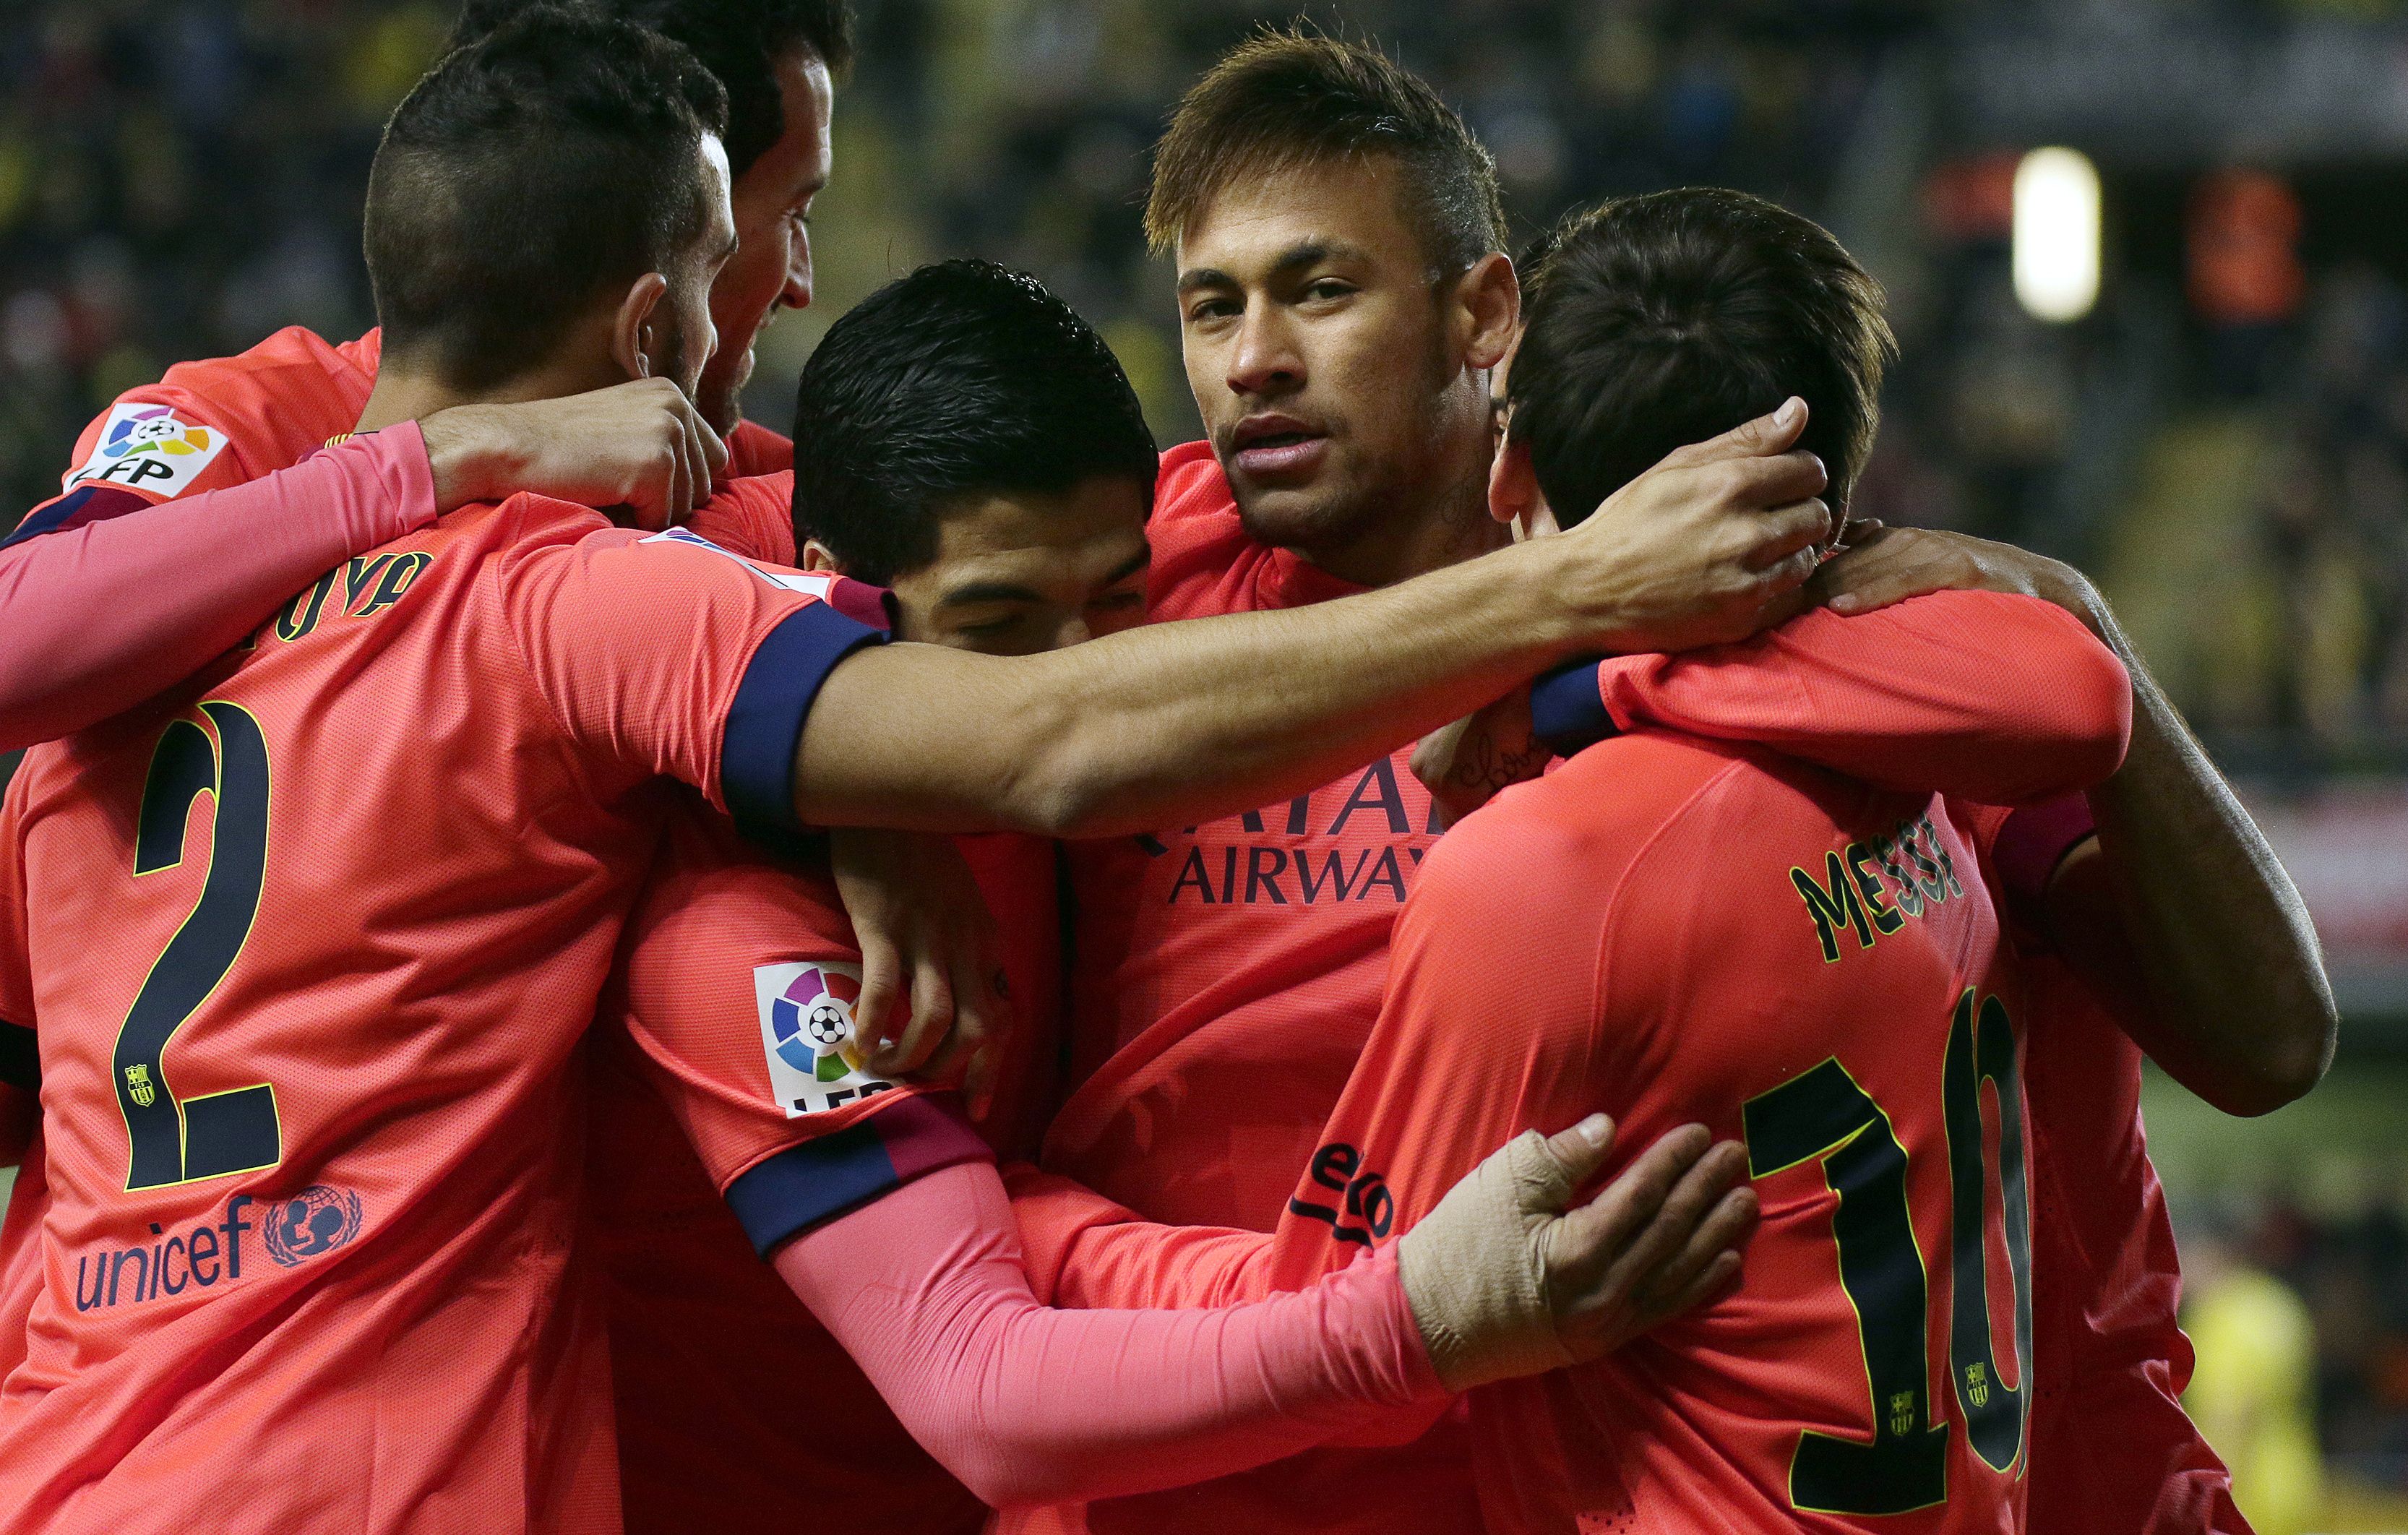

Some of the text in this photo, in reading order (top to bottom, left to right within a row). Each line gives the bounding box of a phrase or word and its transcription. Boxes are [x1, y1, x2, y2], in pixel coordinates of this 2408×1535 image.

[241, 551, 434, 650] OYA
[1168, 844, 1424, 904] AIRWA
[1789, 809, 1964, 963] MESSI
[112, 700, 281, 1192] 2
[76, 1196, 251, 1312] unicef
[1742, 985, 2033, 1516] 10
